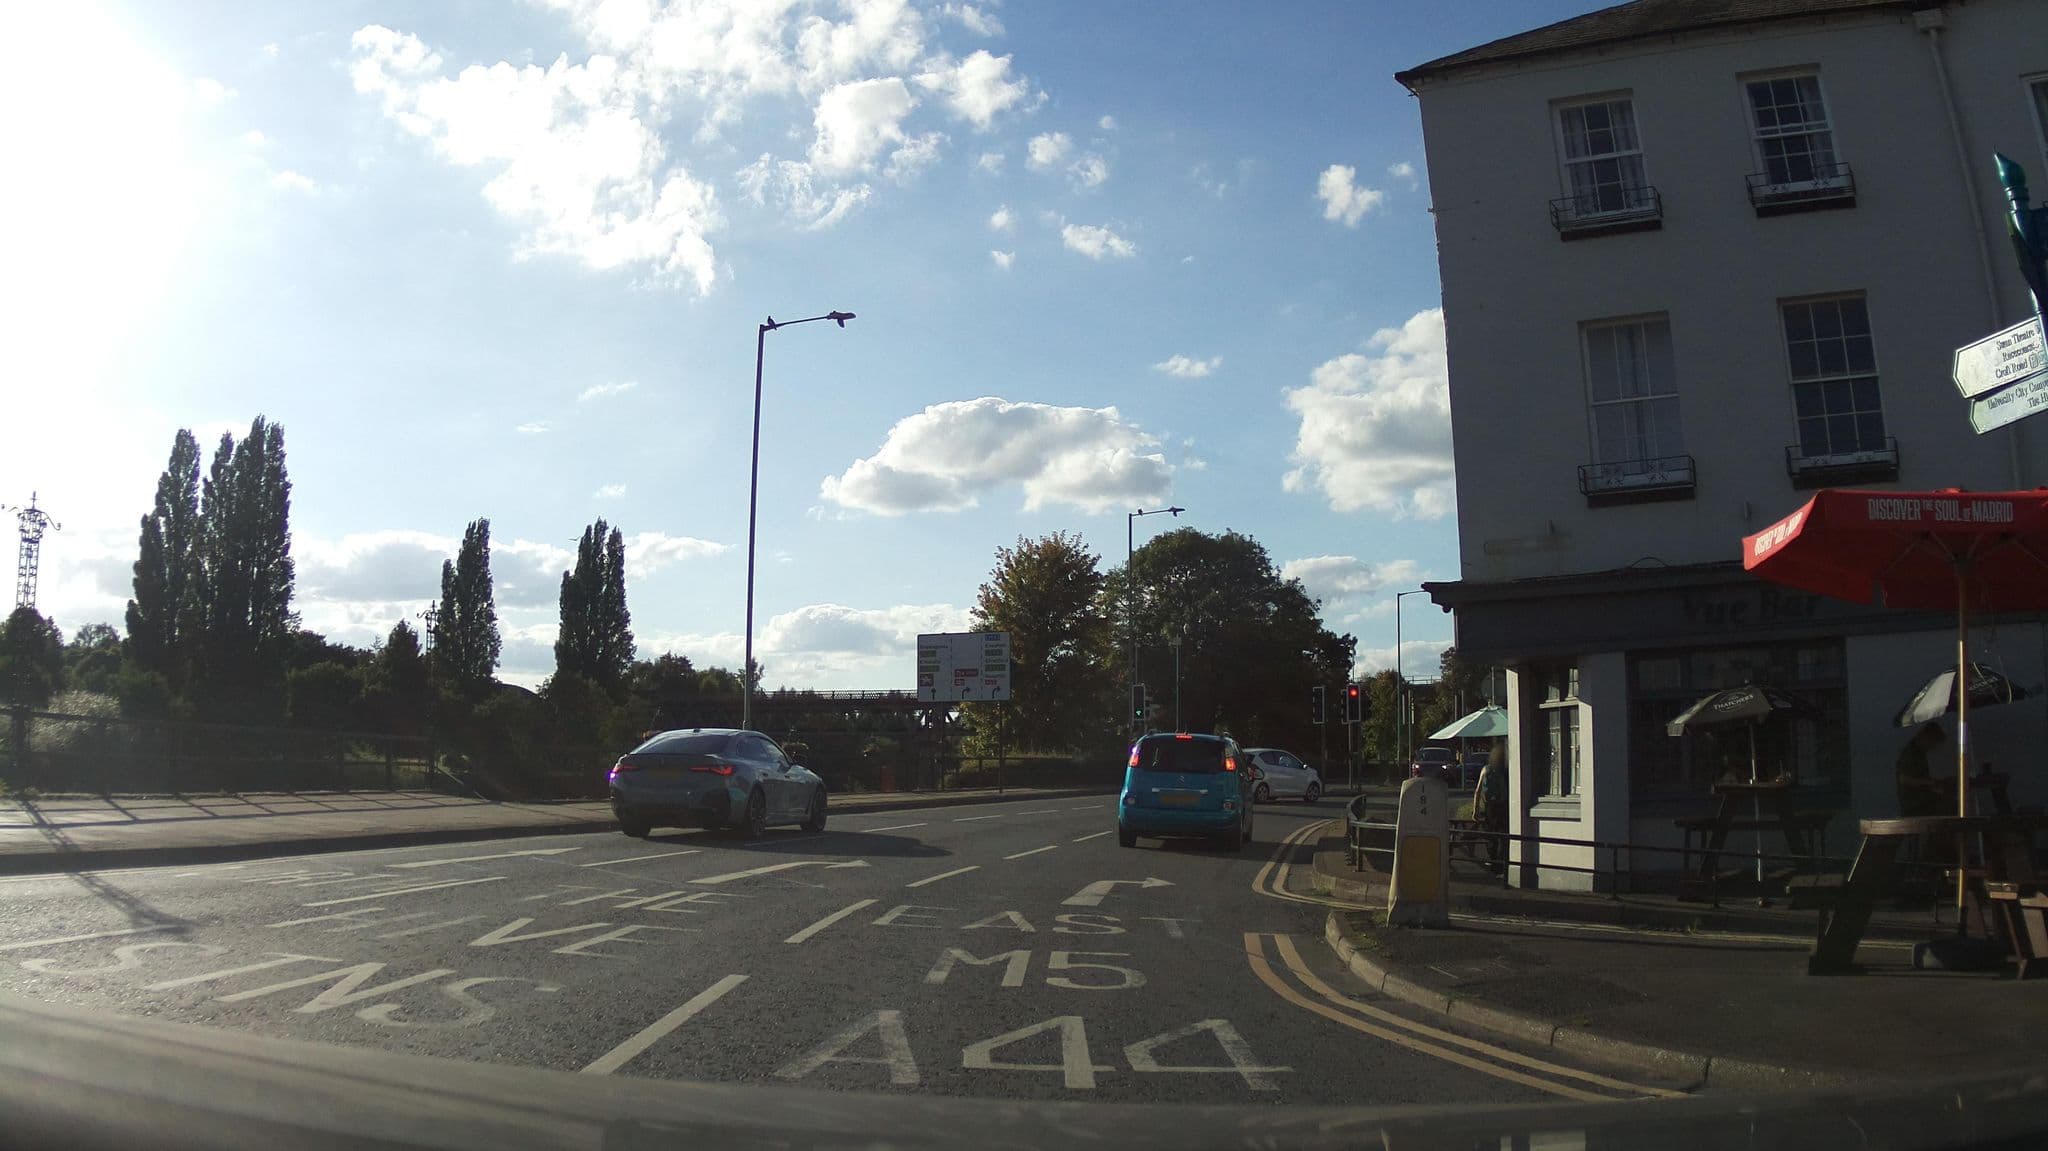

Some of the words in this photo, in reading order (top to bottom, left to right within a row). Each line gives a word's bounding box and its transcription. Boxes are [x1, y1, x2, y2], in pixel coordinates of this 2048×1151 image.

[1996, 339, 2012, 350] Swan
[2012, 329, 2035, 345] Theatre
[1995, 365, 2011, 379] Croft
[2011, 358, 2028, 373] Road
[1987, 392, 2015, 410] University
[2015, 385, 2028, 399] City
[1867, 499, 1921, 521] DISCOVER
[1935, 500, 1961, 522] SOUL
[1972, 501, 2014, 522] MADRID
[871, 904, 1203, 939] EAST
[922, 948, 1149, 990] M5
[773, 1009, 1294, 1092] A44
